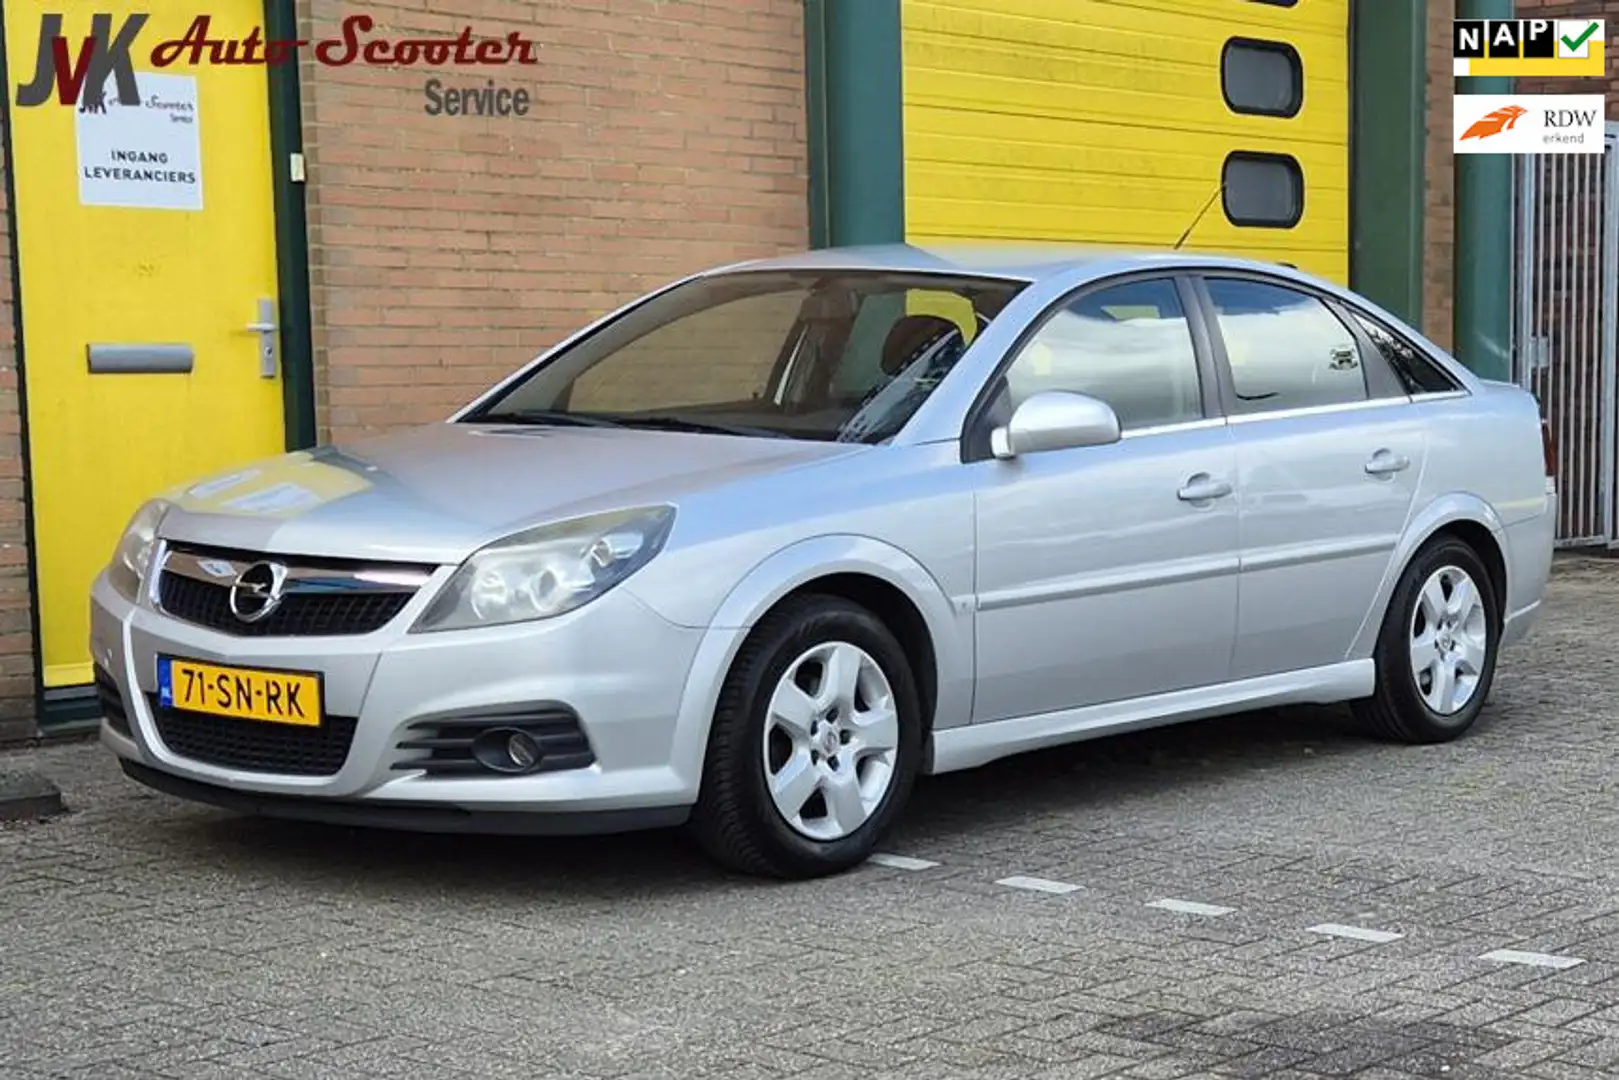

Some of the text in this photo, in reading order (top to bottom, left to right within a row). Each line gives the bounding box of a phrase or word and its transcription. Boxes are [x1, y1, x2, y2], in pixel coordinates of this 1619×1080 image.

[110, 149, 169, 164] INGANG
[83, 166, 196, 184] LEVERANCIERS
[181, 668, 305, 718] 71-SN-RK
